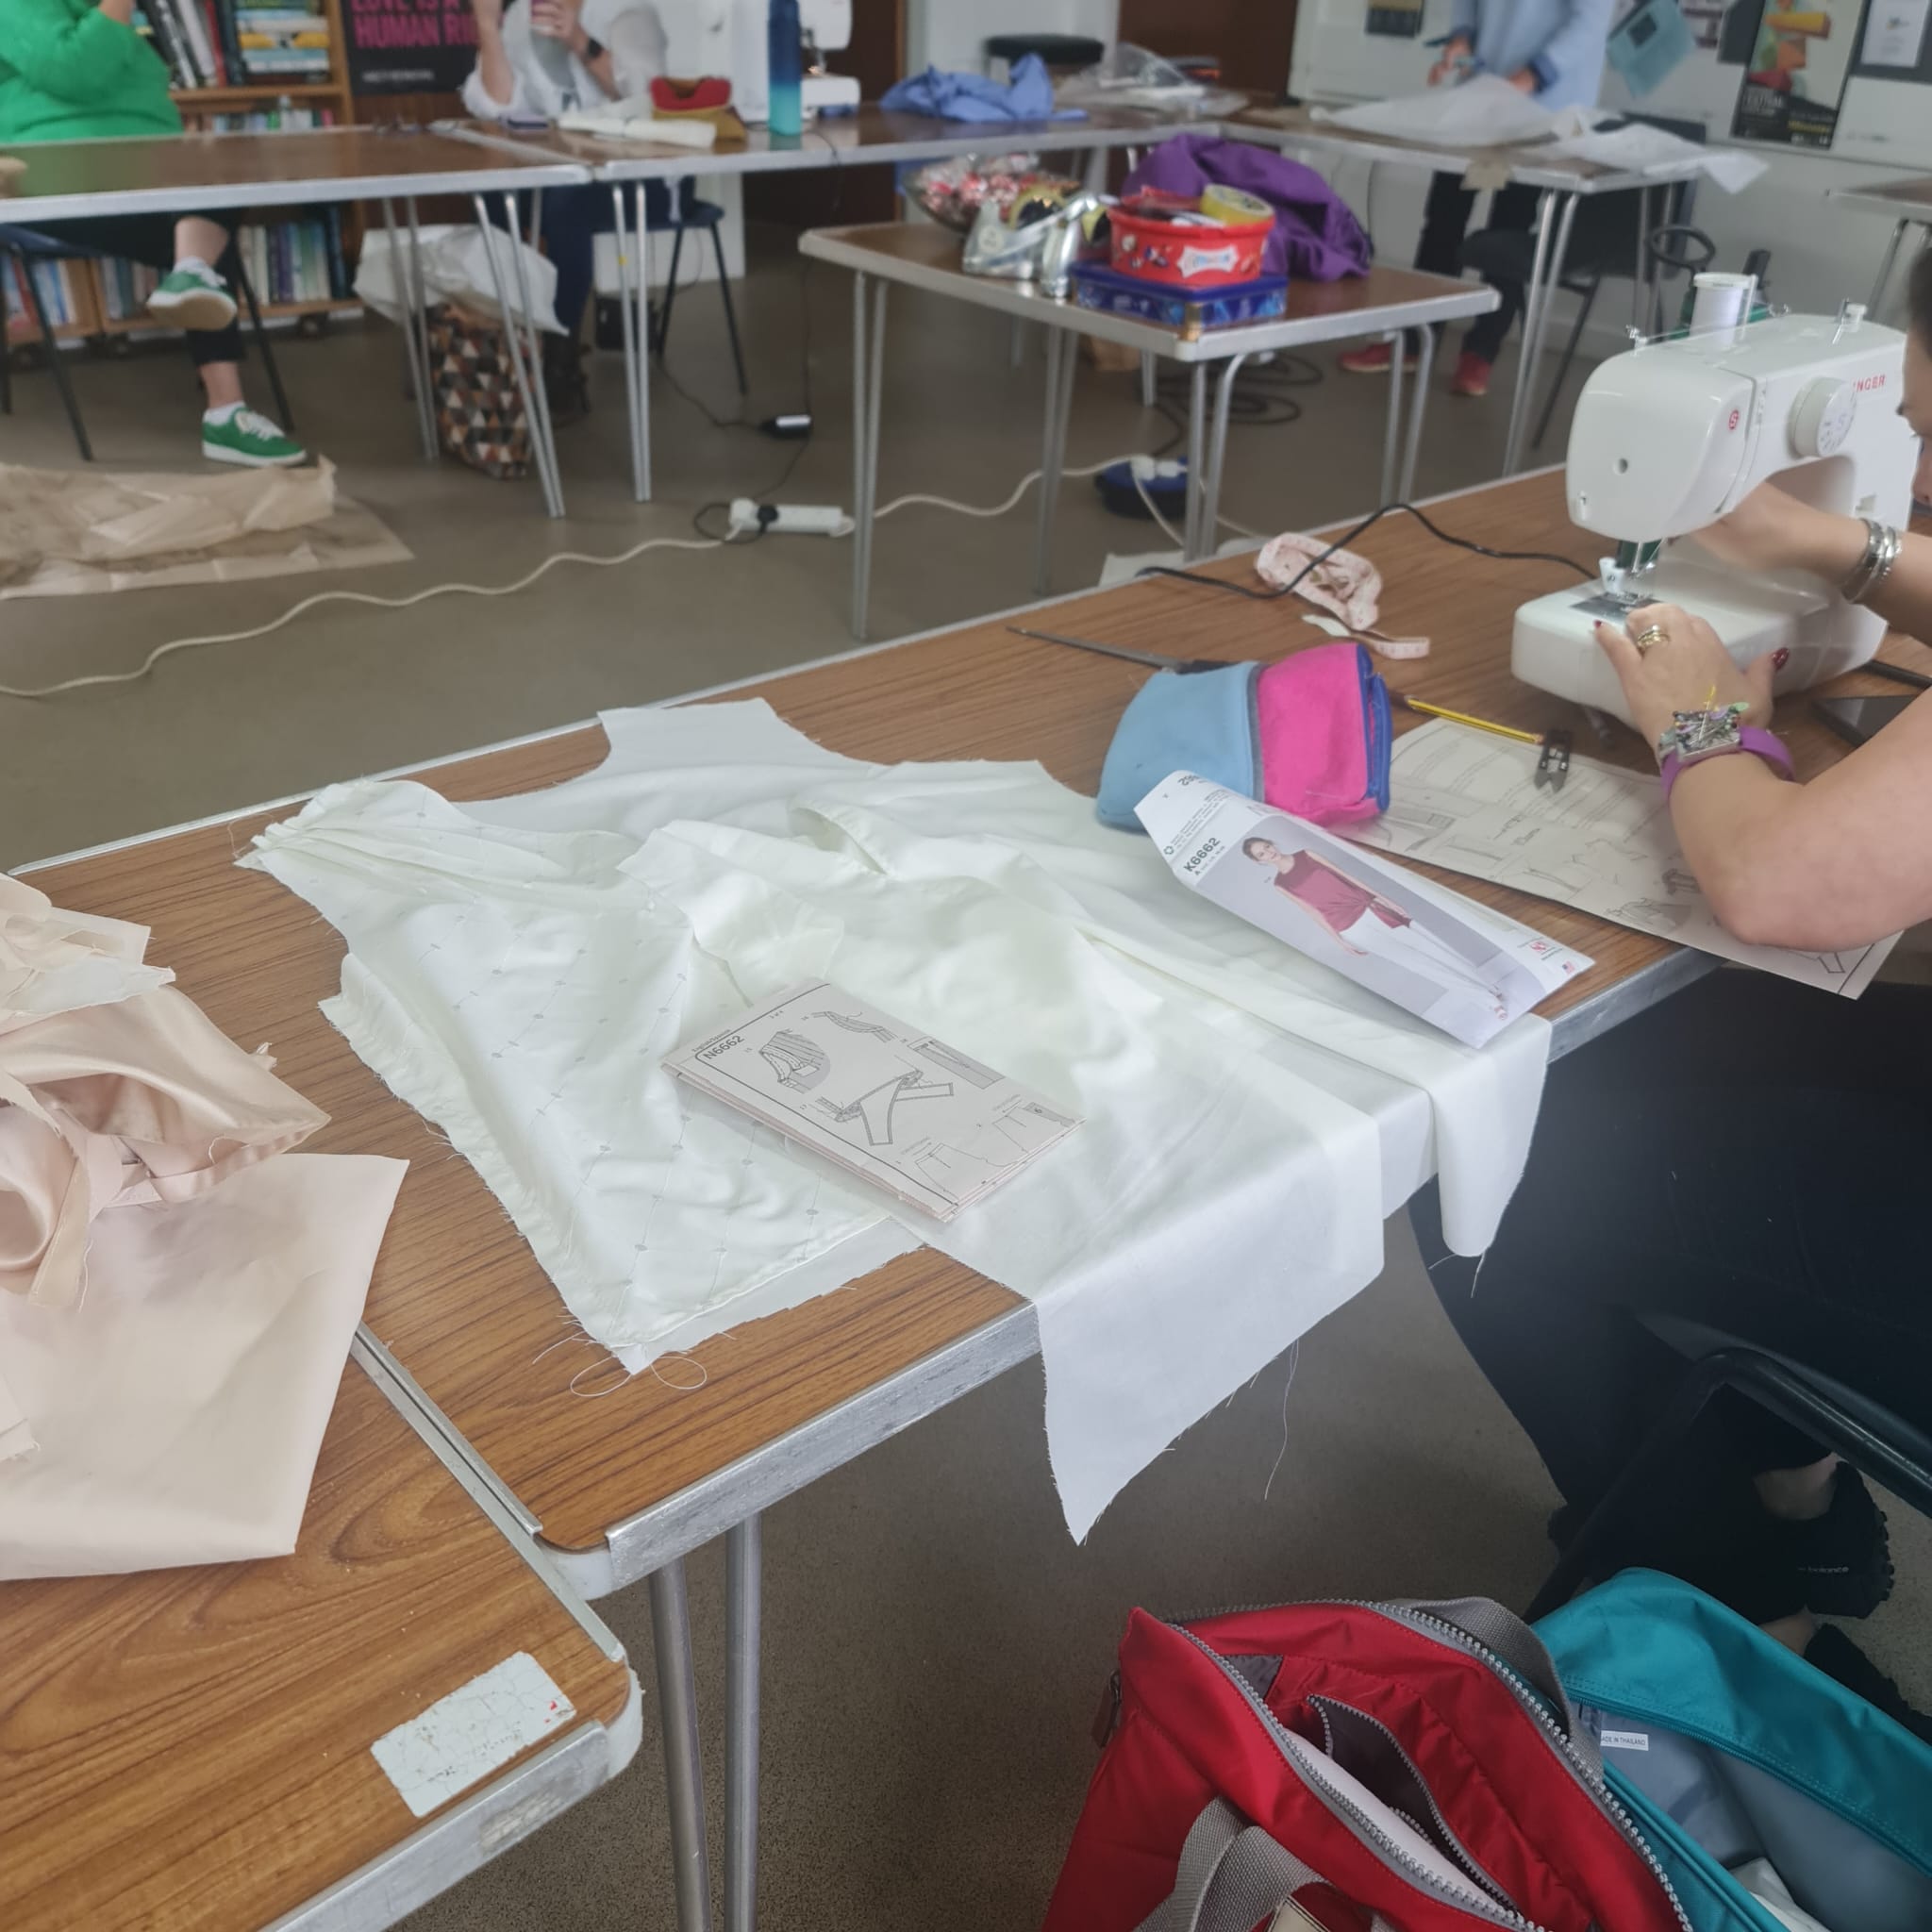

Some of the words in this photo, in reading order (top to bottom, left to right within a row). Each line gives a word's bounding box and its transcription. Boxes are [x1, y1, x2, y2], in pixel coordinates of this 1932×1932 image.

[355, 14, 440, 47] HUMAN
[1183, 837, 1221, 872] K6662
[703, 1035, 745, 1059] N6662
